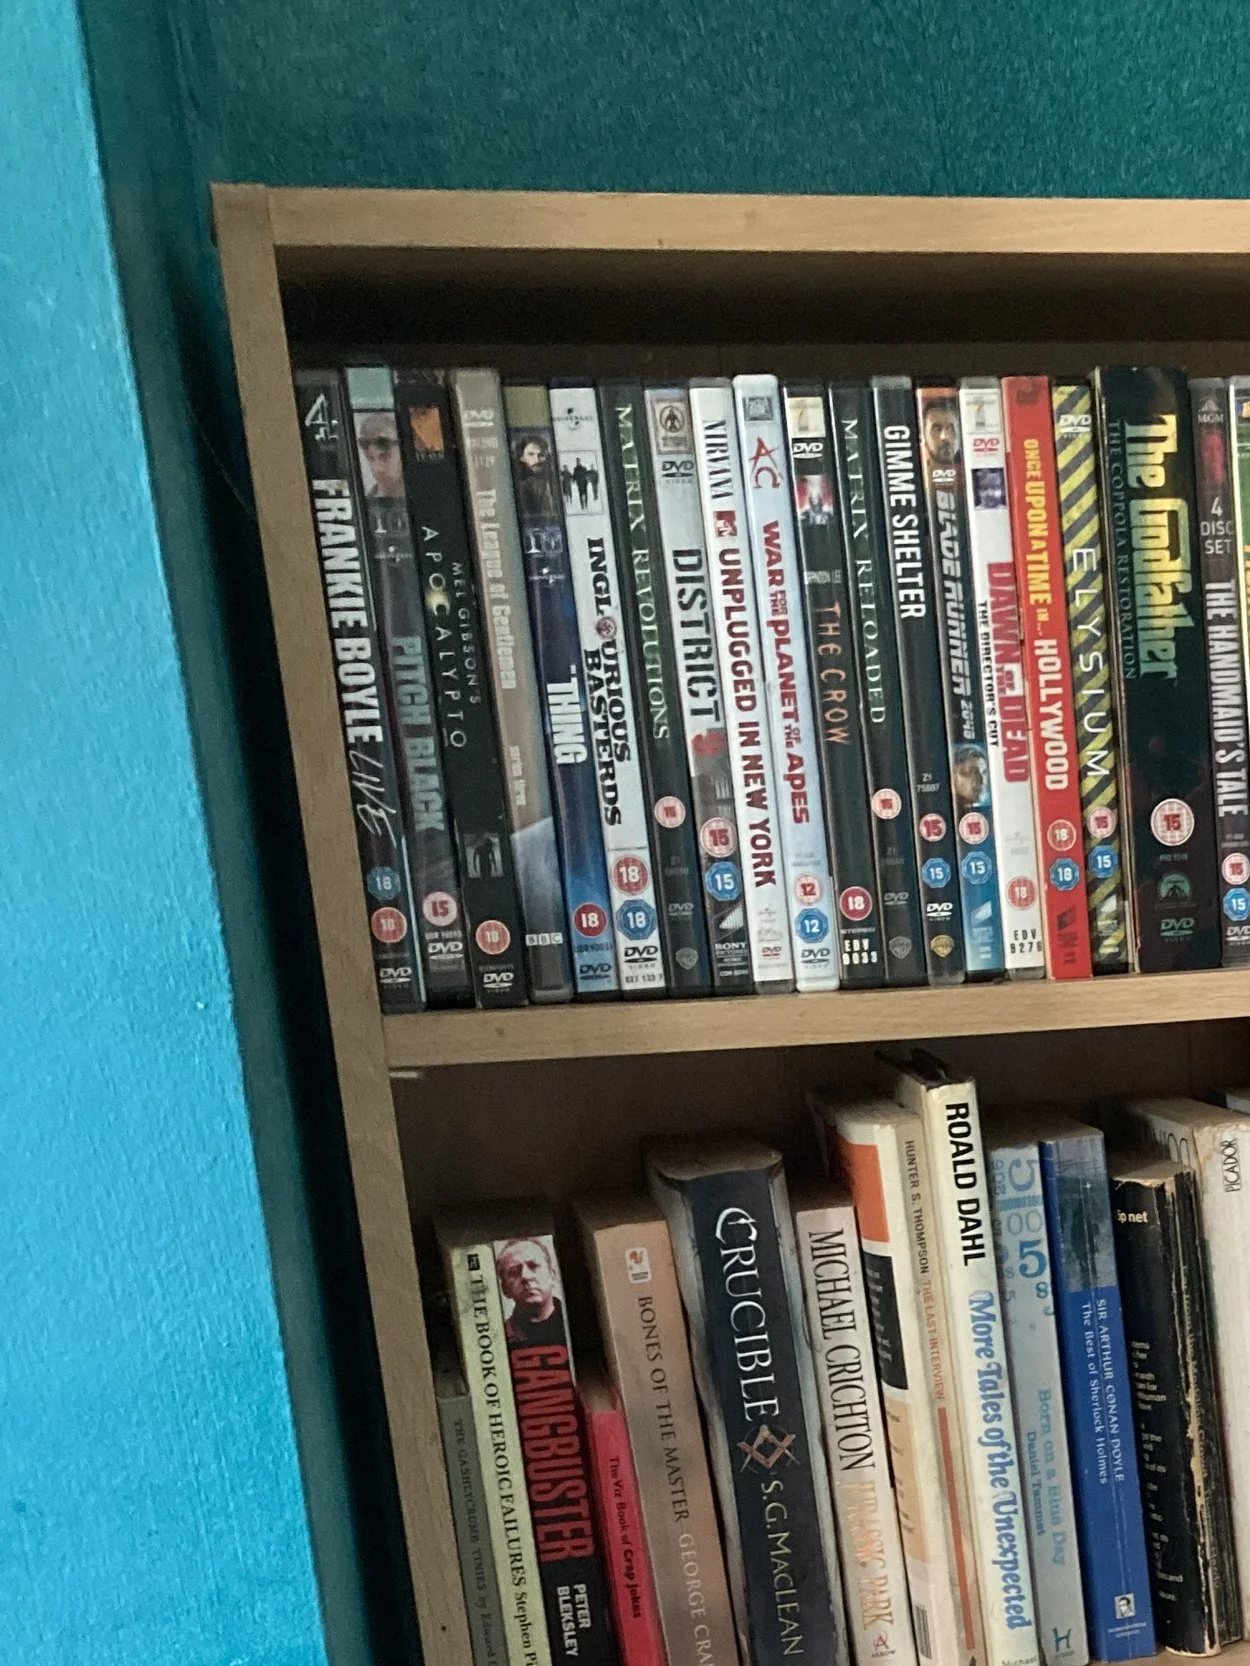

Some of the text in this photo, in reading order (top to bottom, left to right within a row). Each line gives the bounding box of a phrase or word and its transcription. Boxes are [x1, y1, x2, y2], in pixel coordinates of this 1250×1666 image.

[884, 425, 926, 618] GIMME SHELTER
[1204, 539, 1233, 555] SET
[312, 479, 383, 744] FRANKIE BOYLE
[673, 549, 719, 722] DISTRICT
[719, 548, 757, 712] UNPLUGGED
[1023, 438, 1069, 790] ONCE UPON TIME HOLLYWOOD
[1204, 580, 1237, 620] THE
[762, 520, 810, 825] WAR PLANET APES
[1073, 549, 1109, 777] ELYSIUM
[546, 682, 589, 765] THING
[738, 721, 761, 748] IN
[820, 668, 850, 745] CROW
[740, 754, 768, 811] NEW
[1215, 768, 1249, 818] TALE
[748, 816, 776, 888] YORK
[904, 1139, 920, 1190] HUNTER
[945, 1102, 987, 1268] ROALD DAHL
[1223, 1137, 1241, 1193] PICADOR
[716, 1205, 780, 1422] CRUCIBLE
[808, 1229, 876, 1473] MICHAEL CRICHTON
[1081, 1301, 1093, 1328] The
[1096, 1298, 1125, 1483] SIR ARTHUR CONAN DOYLE
[510, 1343, 595, 1564] GANGBUSTER
[662, 1448, 690, 1525] MASTER
[484, 1383, 501, 1410] OF
[513, 1591, 531, 1649] Stephen
[614, 1502, 637, 1585] Book Crap
[557, 1583, 592, 1657] PETER BLEKSLEY
